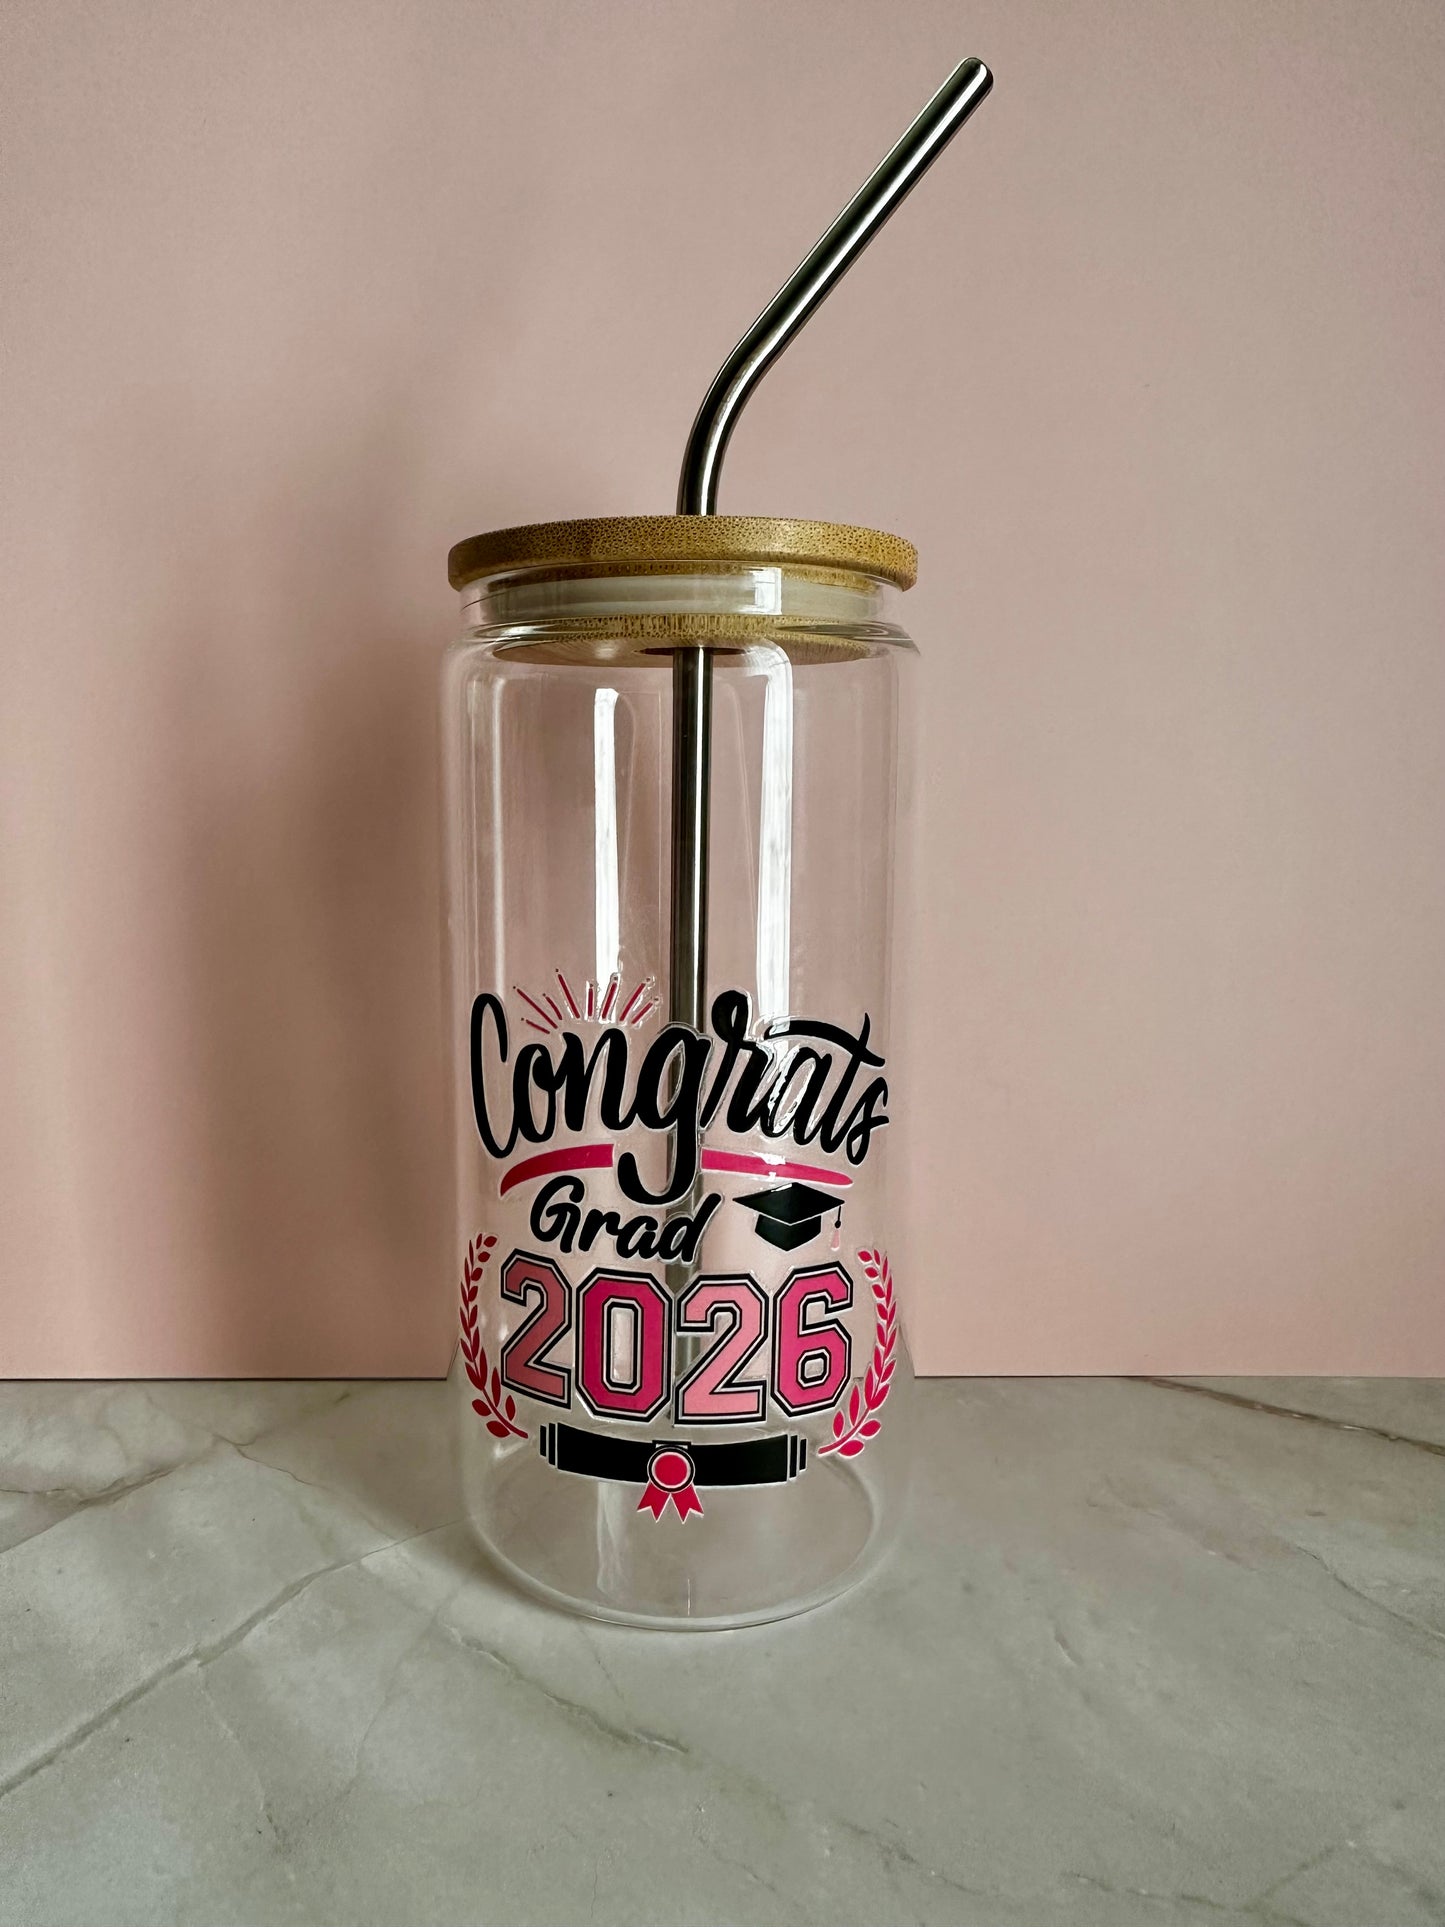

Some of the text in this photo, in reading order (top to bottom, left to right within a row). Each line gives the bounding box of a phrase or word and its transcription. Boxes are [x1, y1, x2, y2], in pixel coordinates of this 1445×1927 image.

[470, 989, 889, 1203] Congrats
[529, 1175, 722, 1264] Grad
[500, 1249, 854, 1426] 2026
